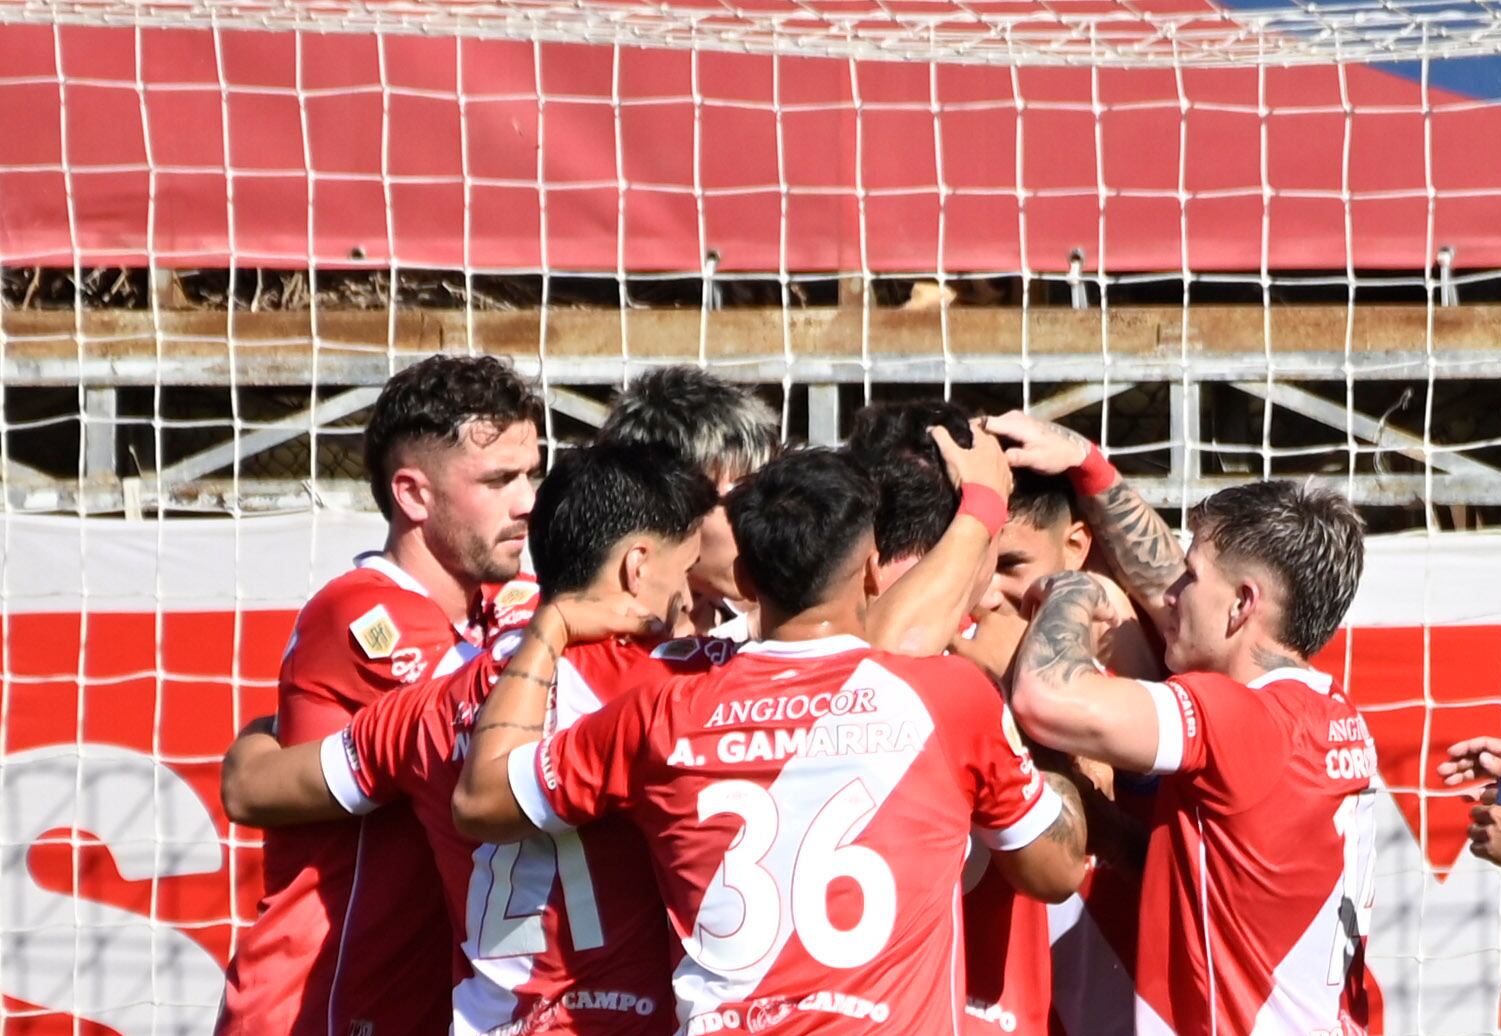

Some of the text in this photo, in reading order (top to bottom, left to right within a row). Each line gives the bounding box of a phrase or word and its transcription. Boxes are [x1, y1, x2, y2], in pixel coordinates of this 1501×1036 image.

[703, 688, 877, 728] ANGIOCOR
[667, 720, 925, 767] A. GAMARRA
[697, 777, 897, 973] 36
[561, 991, 654, 1016] CAMPO
[797, 991, 890, 1023] CAMPO
